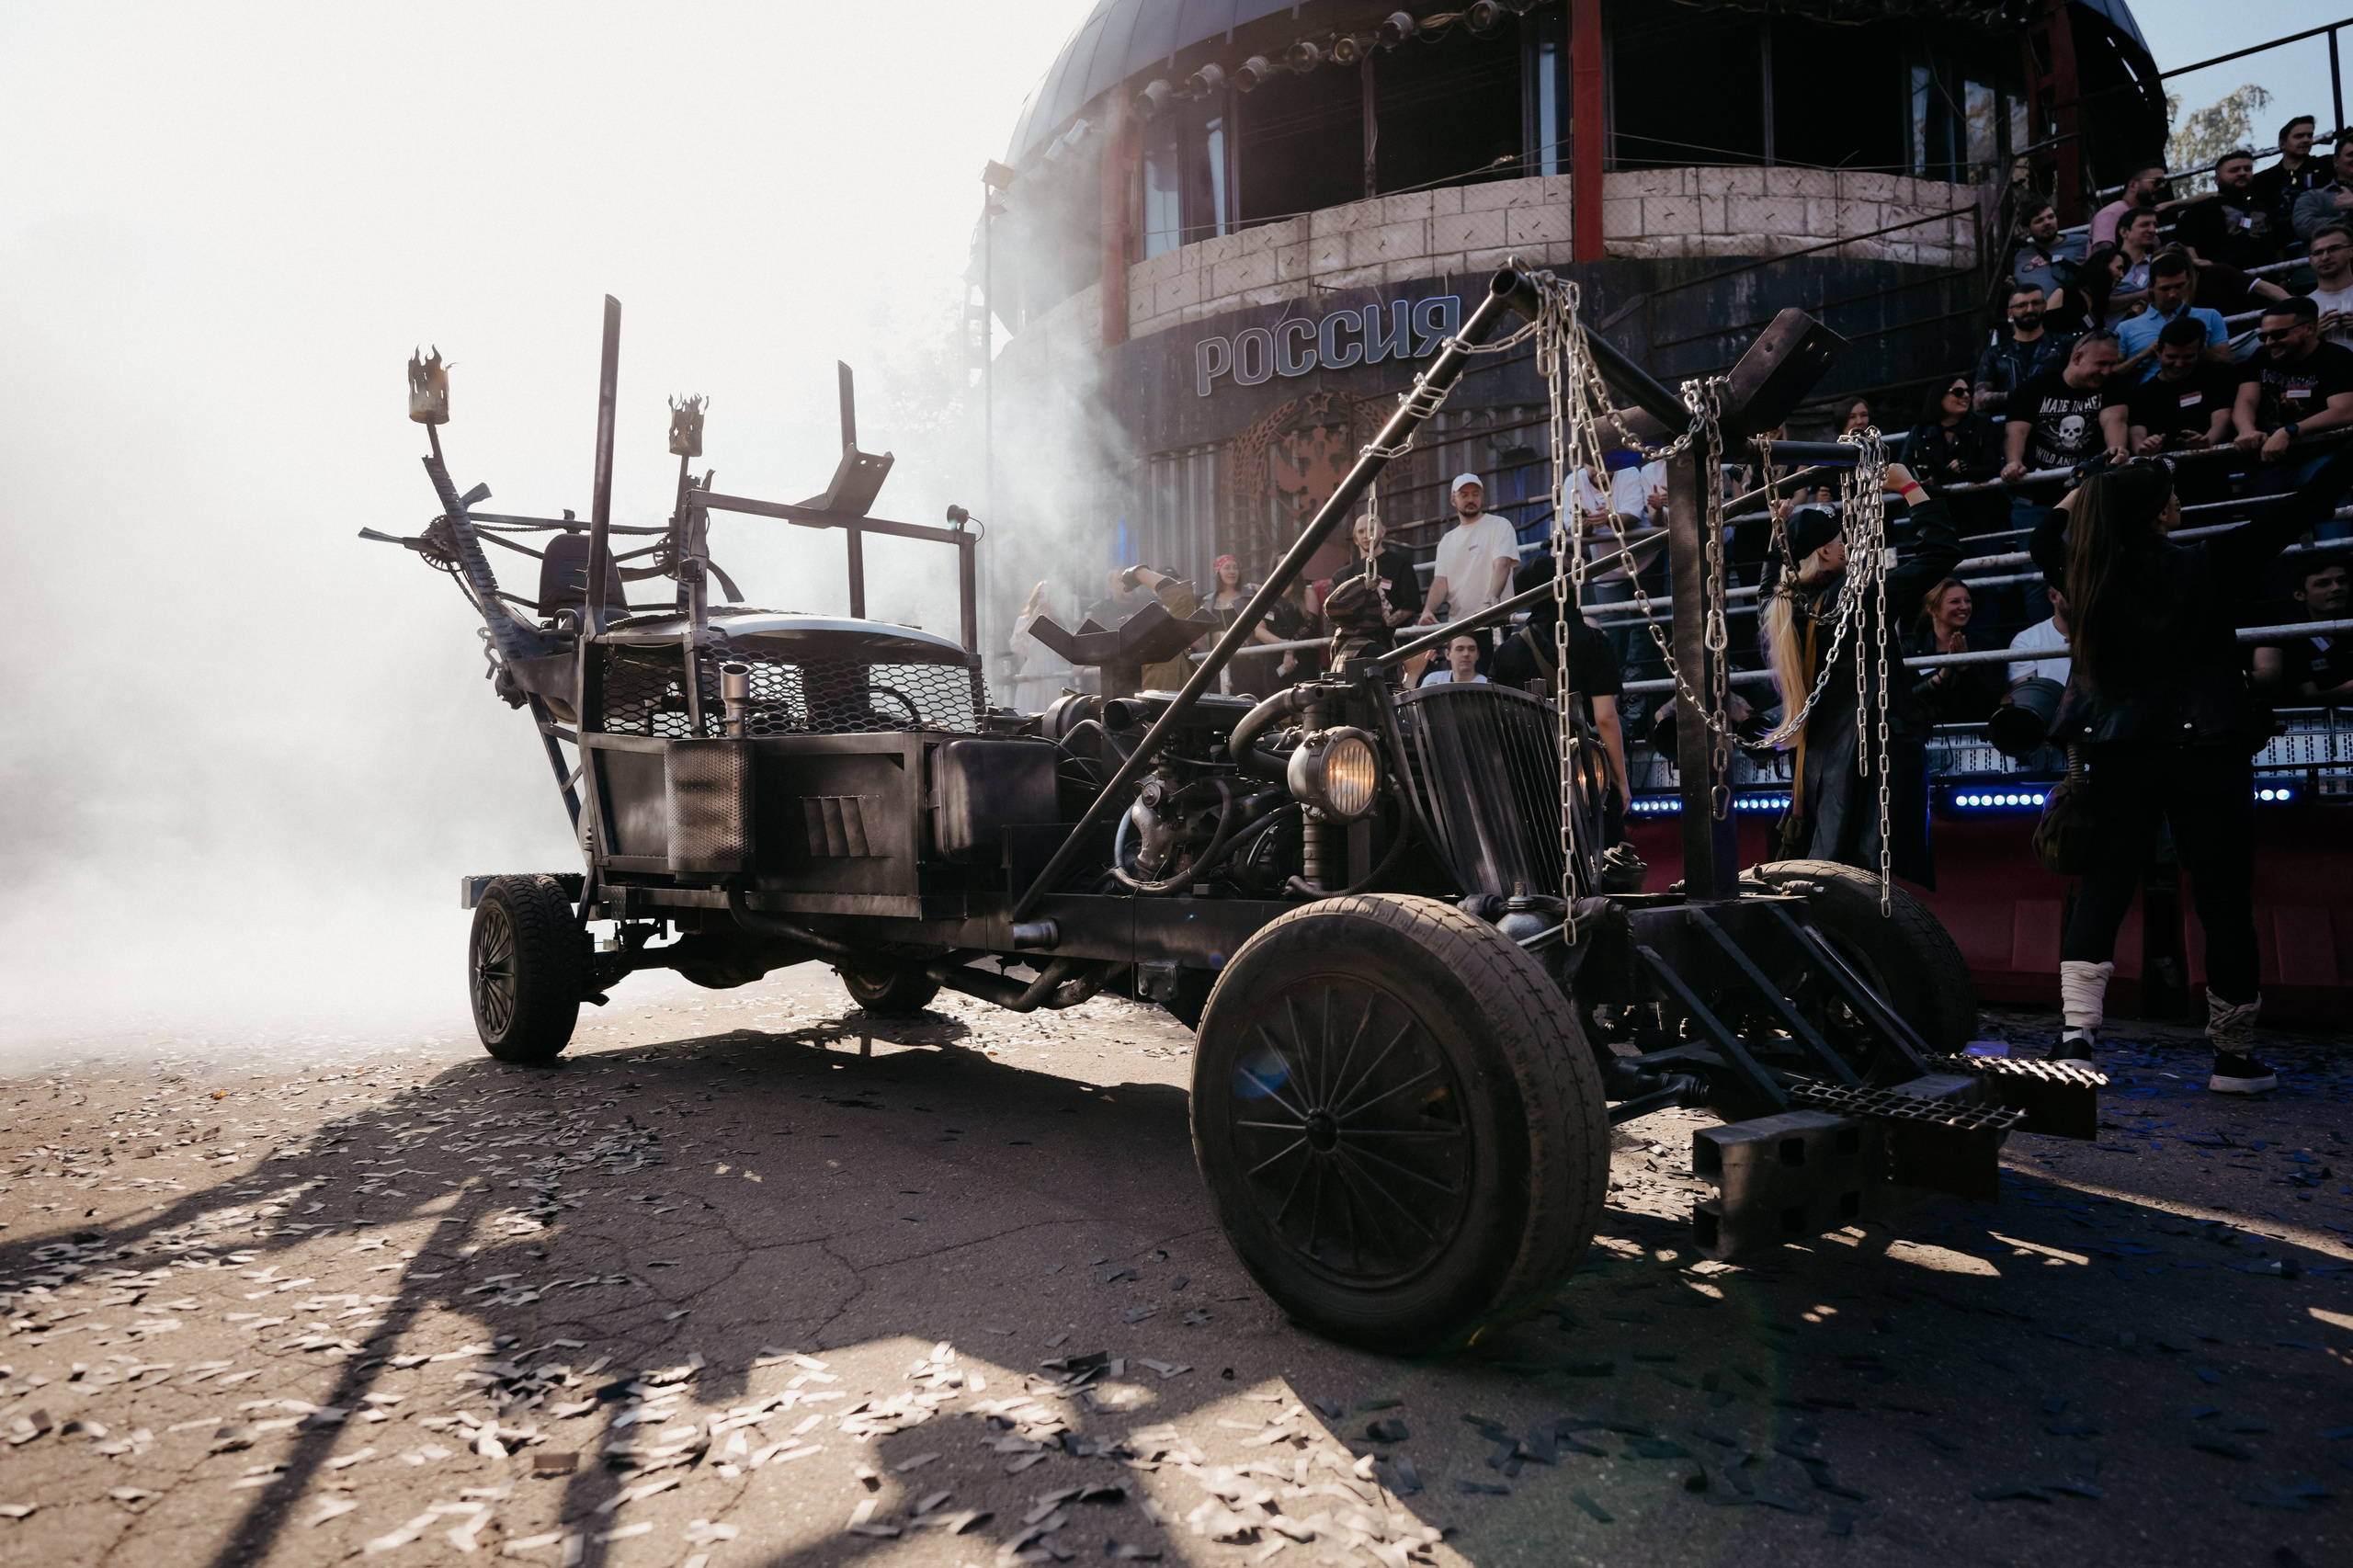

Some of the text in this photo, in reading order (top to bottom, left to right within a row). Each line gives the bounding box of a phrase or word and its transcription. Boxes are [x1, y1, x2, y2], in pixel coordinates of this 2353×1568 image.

[1196, 295, 1461, 397] РОССИЯ
[2071, 400, 2084, 413] IN
[2036, 445, 2056, 464] WILD
